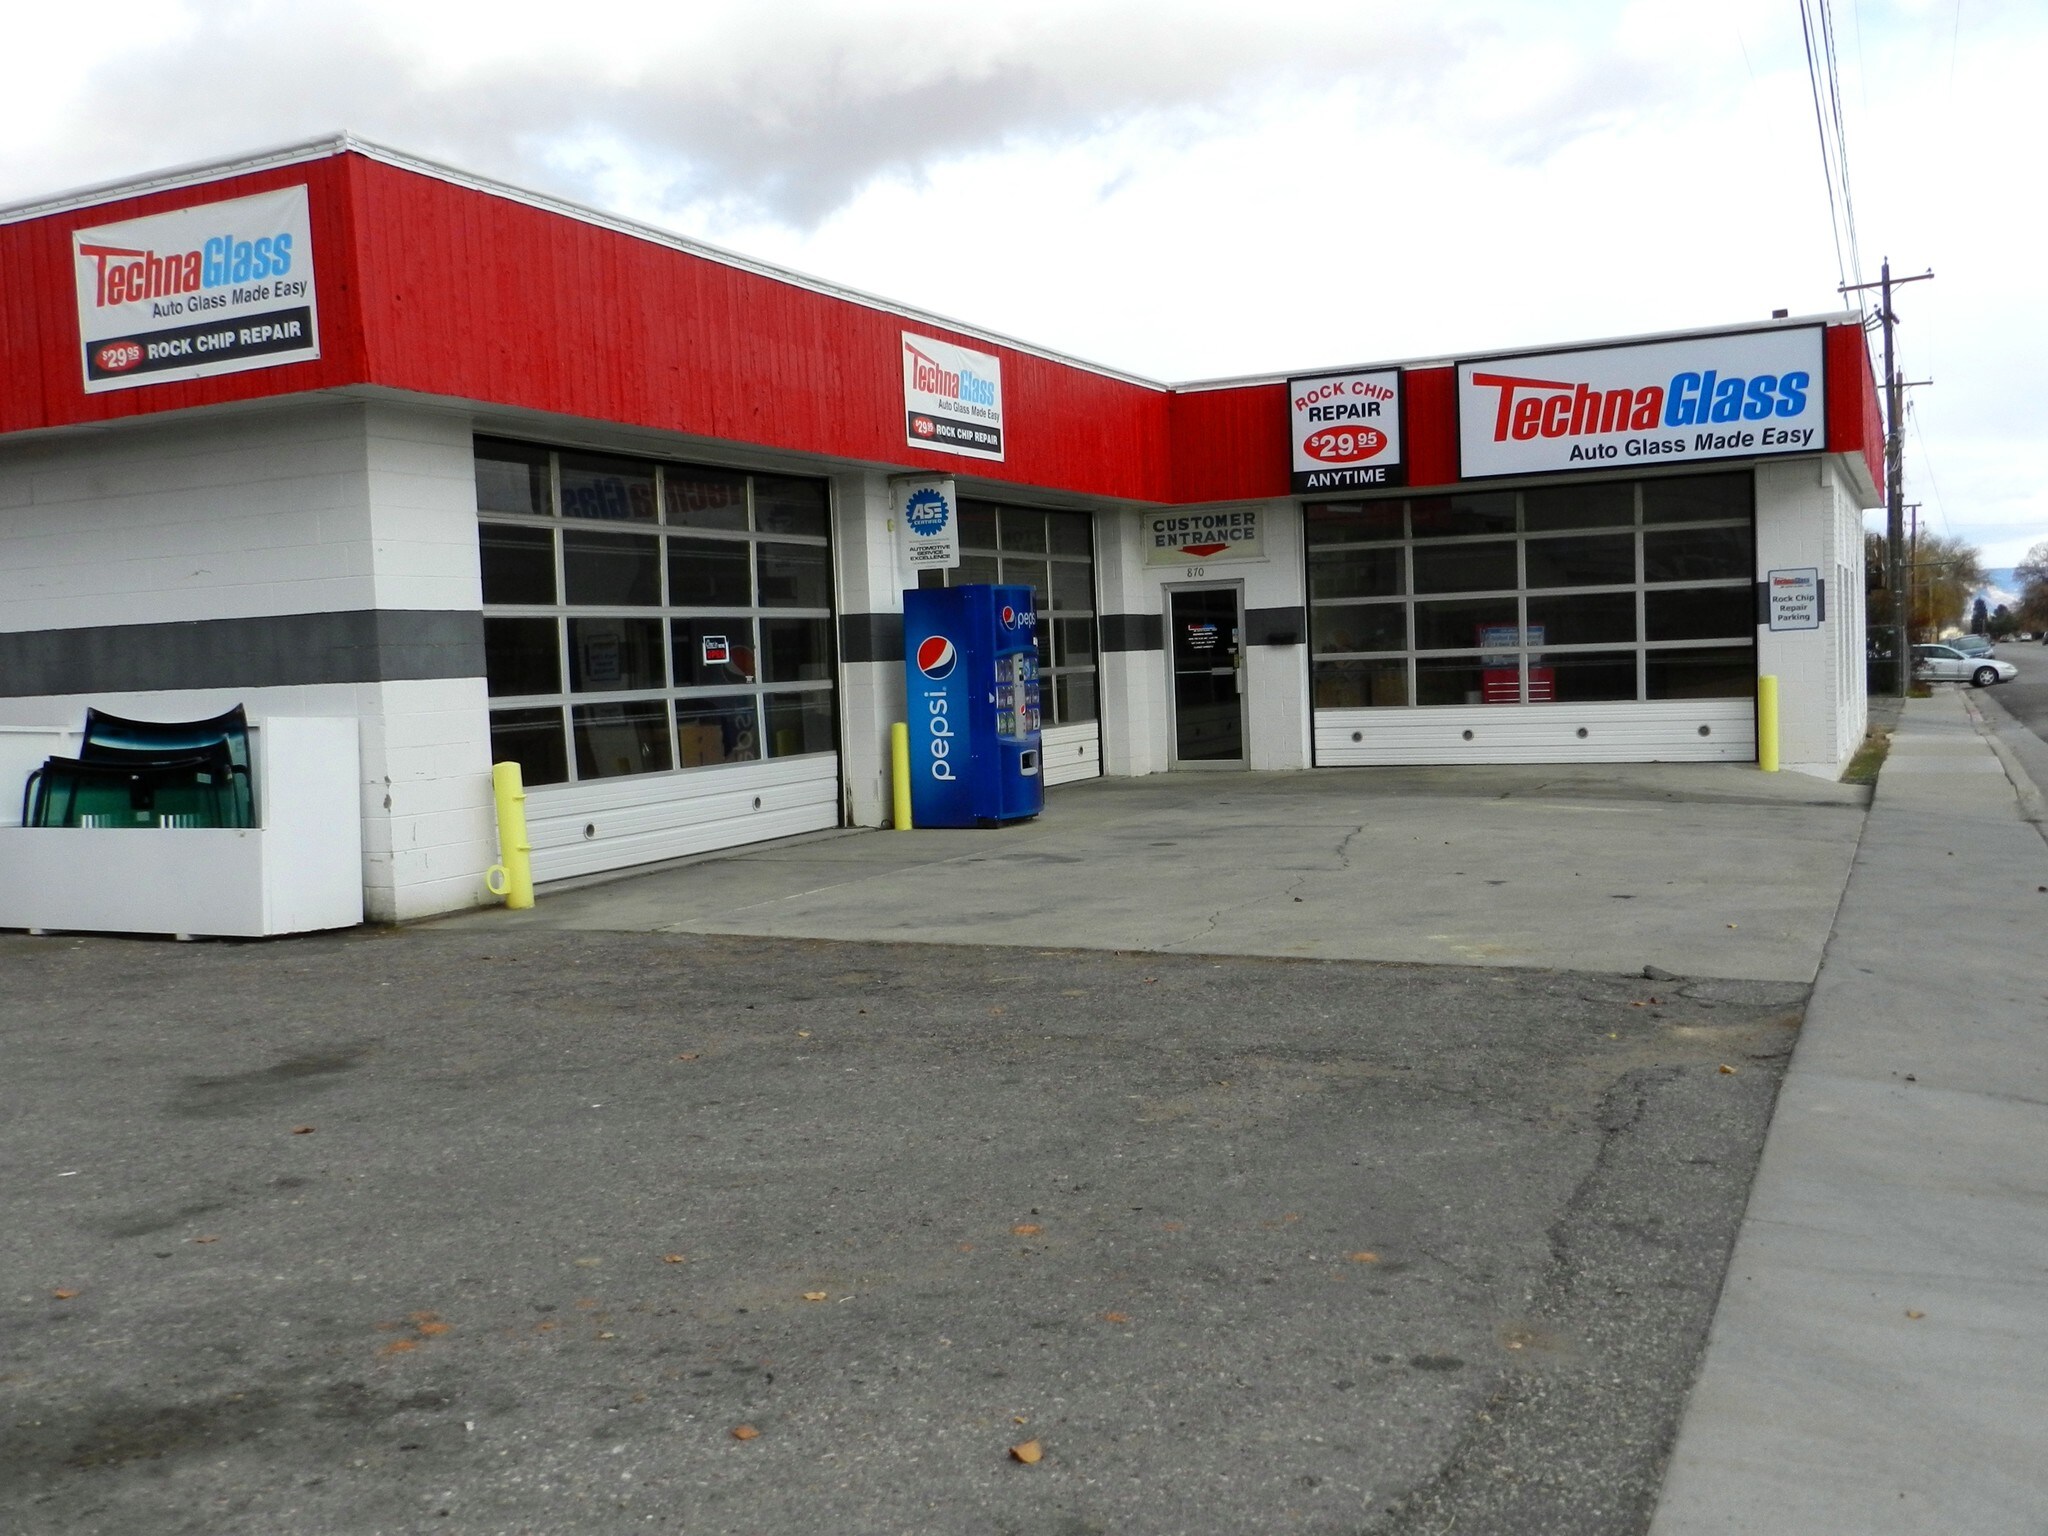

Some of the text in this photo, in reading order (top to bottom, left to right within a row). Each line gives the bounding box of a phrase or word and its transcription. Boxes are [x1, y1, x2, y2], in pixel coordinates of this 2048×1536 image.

[80, 233, 292, 307] TechnaGlass
[152, 280, 307, 318] Auto Glass Made Easy
[147, 337, 192, 359] ROCK
[196, 331, 235, 352] CHIP
[240, 320, 301, 345] REPAIR
[905, 341, 995, 407] TechnaGlass
[1295, 381, 1394, 411] ROCK CHIP
[1472, 370, 1810, 441] TechnaGlass
[938, 399, 1000, 423] Auto Glass Made Easy
[1308, 401, 1381, 423] REPAIR
[936, 424, 956, 438] ROCK
[957, 428, 973, 441] CHIP
[974, 431, 998, 446] REPAIR
[1569, 427, 1814, 462] Auto Glass Made Easy
[1307, 468, 1386, 487] ANYTIME
[912, 502, 943, 521] ASE
[1153, 512, 1256, 533] CUSTOMER
[909, 544, 951, 552] AUTOMOTIVE
[1155, 527, 1255, 547] ENTRANCE
[1187, 567, 1204, 578] 870
[1772, 594, 1815, 603] Rock Chip
[1780, 604, 1808, 612] Repair
[924, 689, 956, 782] pepsi
